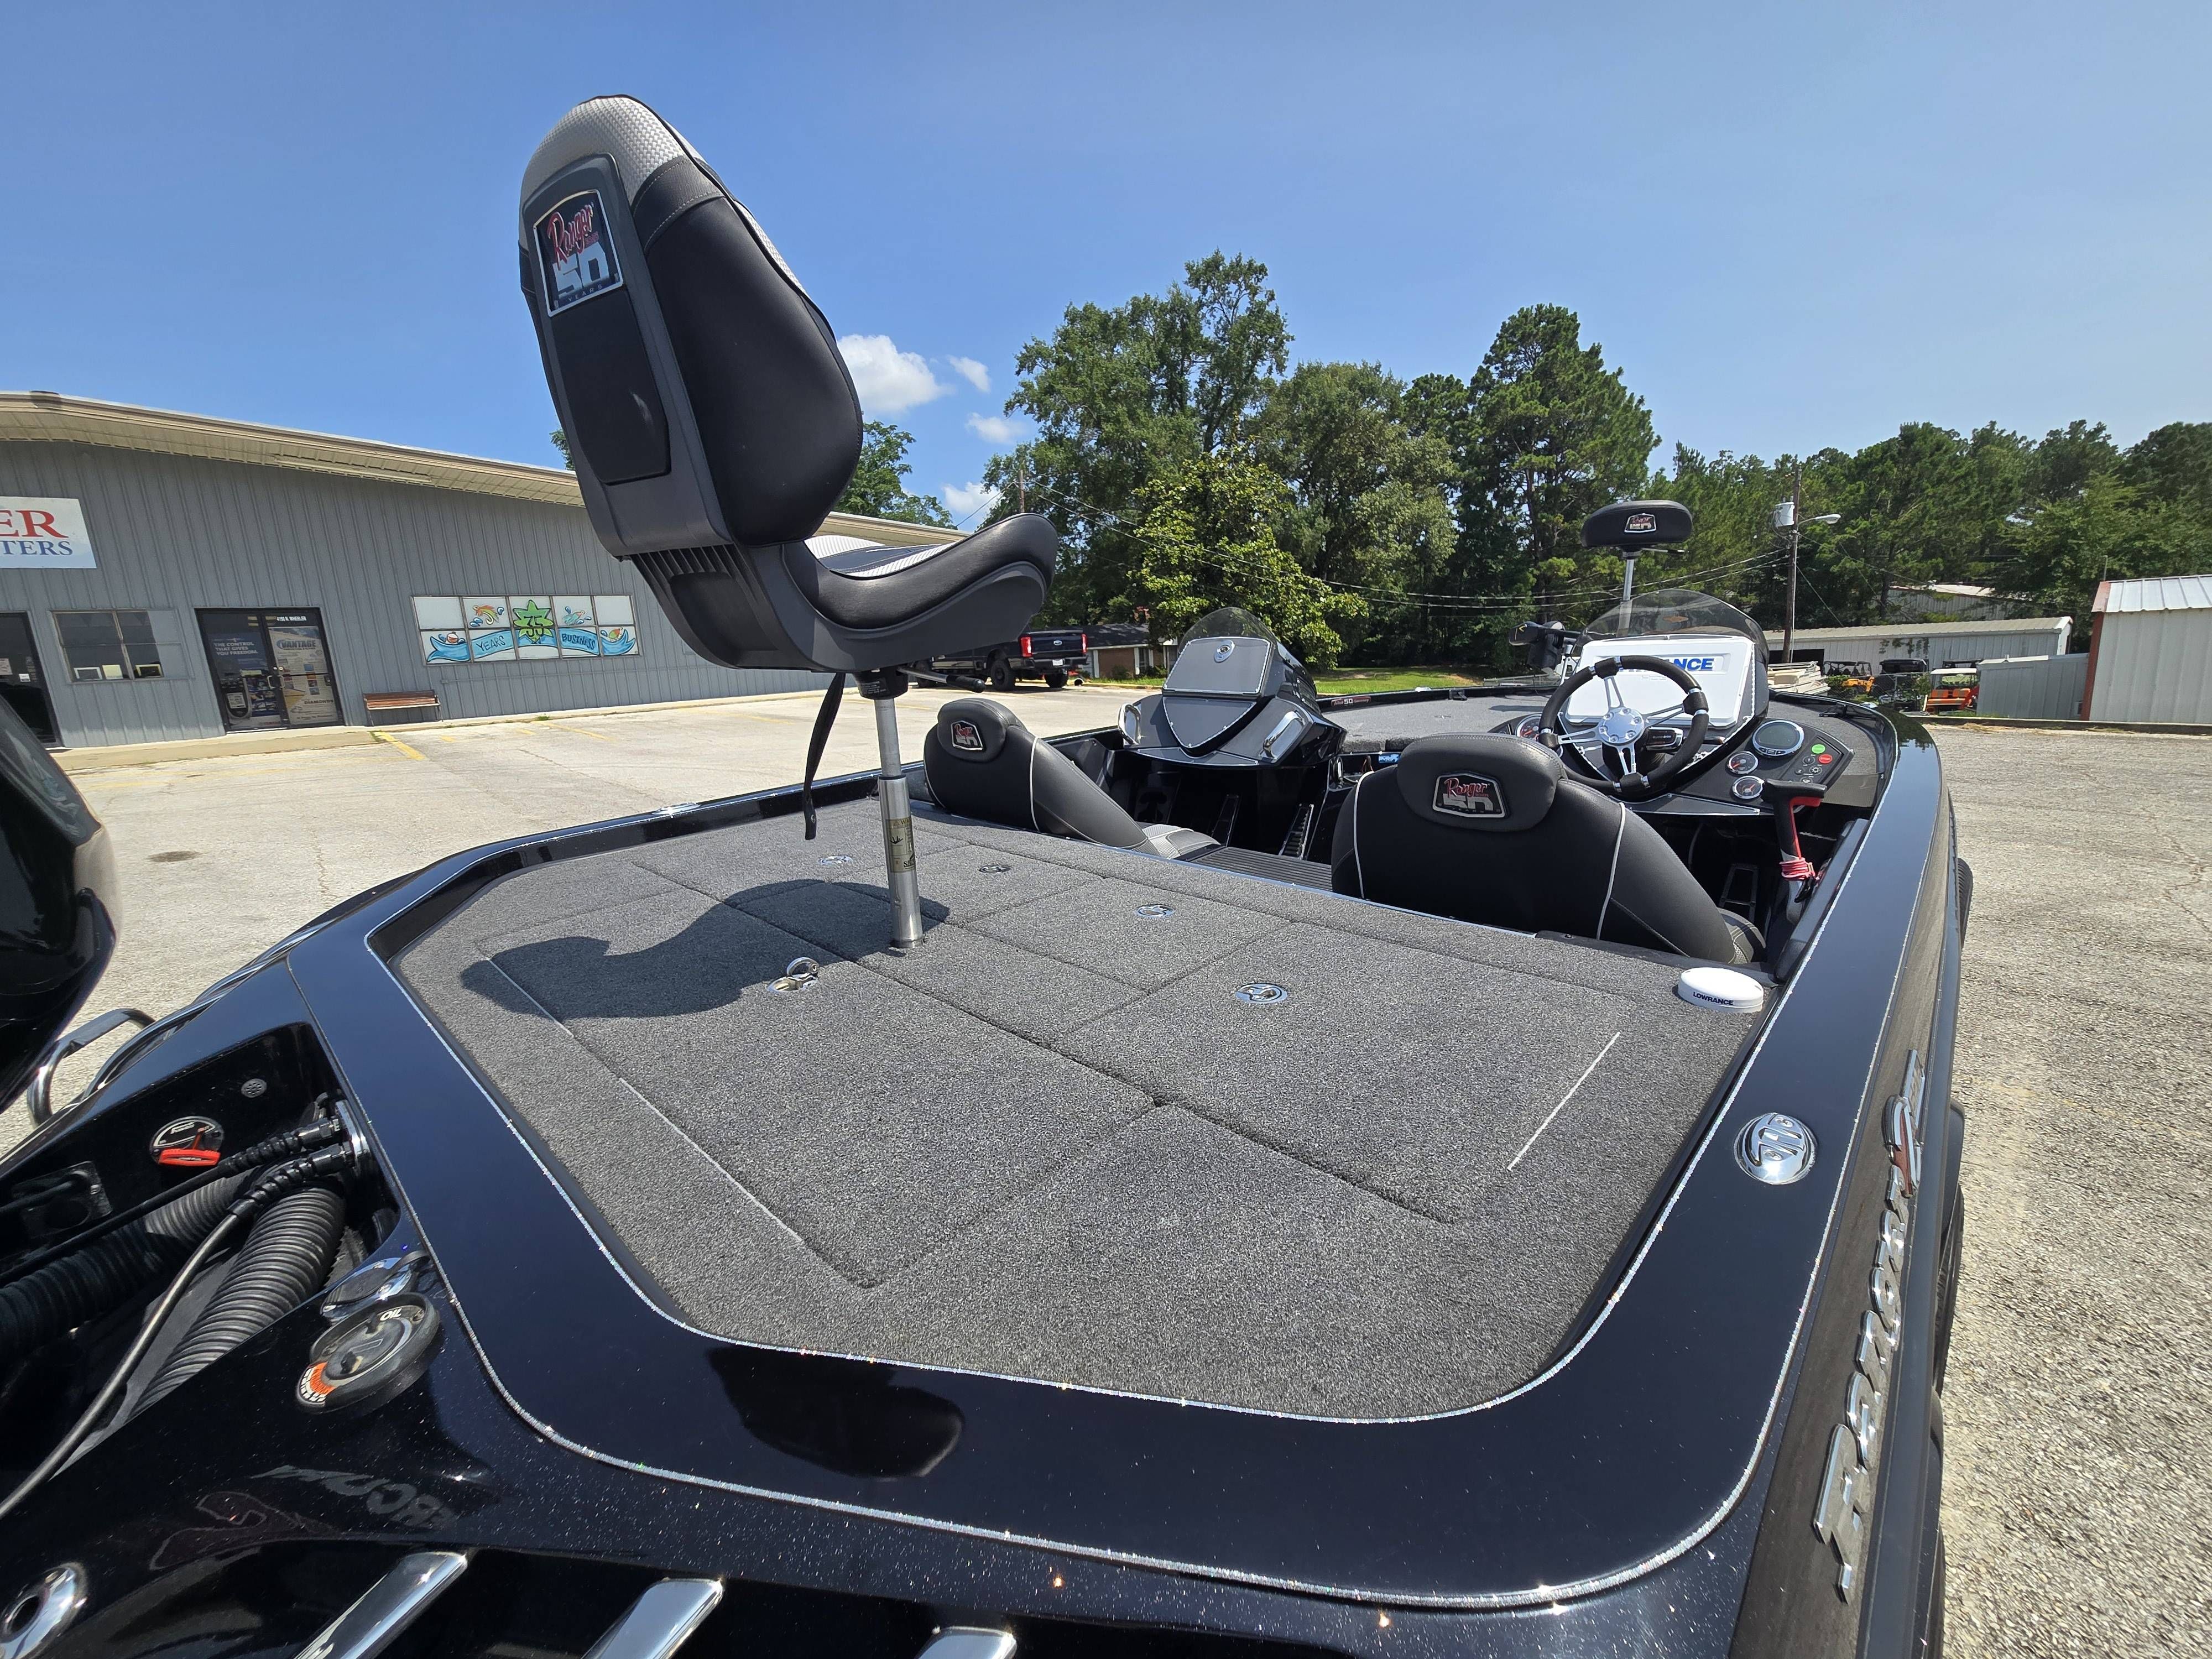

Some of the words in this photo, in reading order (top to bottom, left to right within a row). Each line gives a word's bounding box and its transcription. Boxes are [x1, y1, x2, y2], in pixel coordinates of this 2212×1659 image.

[546, 204, 593, 271] Ranger
[476, 635, 505, 651] YEARS
[561, 633, 596, 650] BUSINESS
[1444, 778, 1488, 797] Ranger
[1693, 991, 1734, 1005] LOWRANCE
[379, 1308, 402, 1321] OIL
